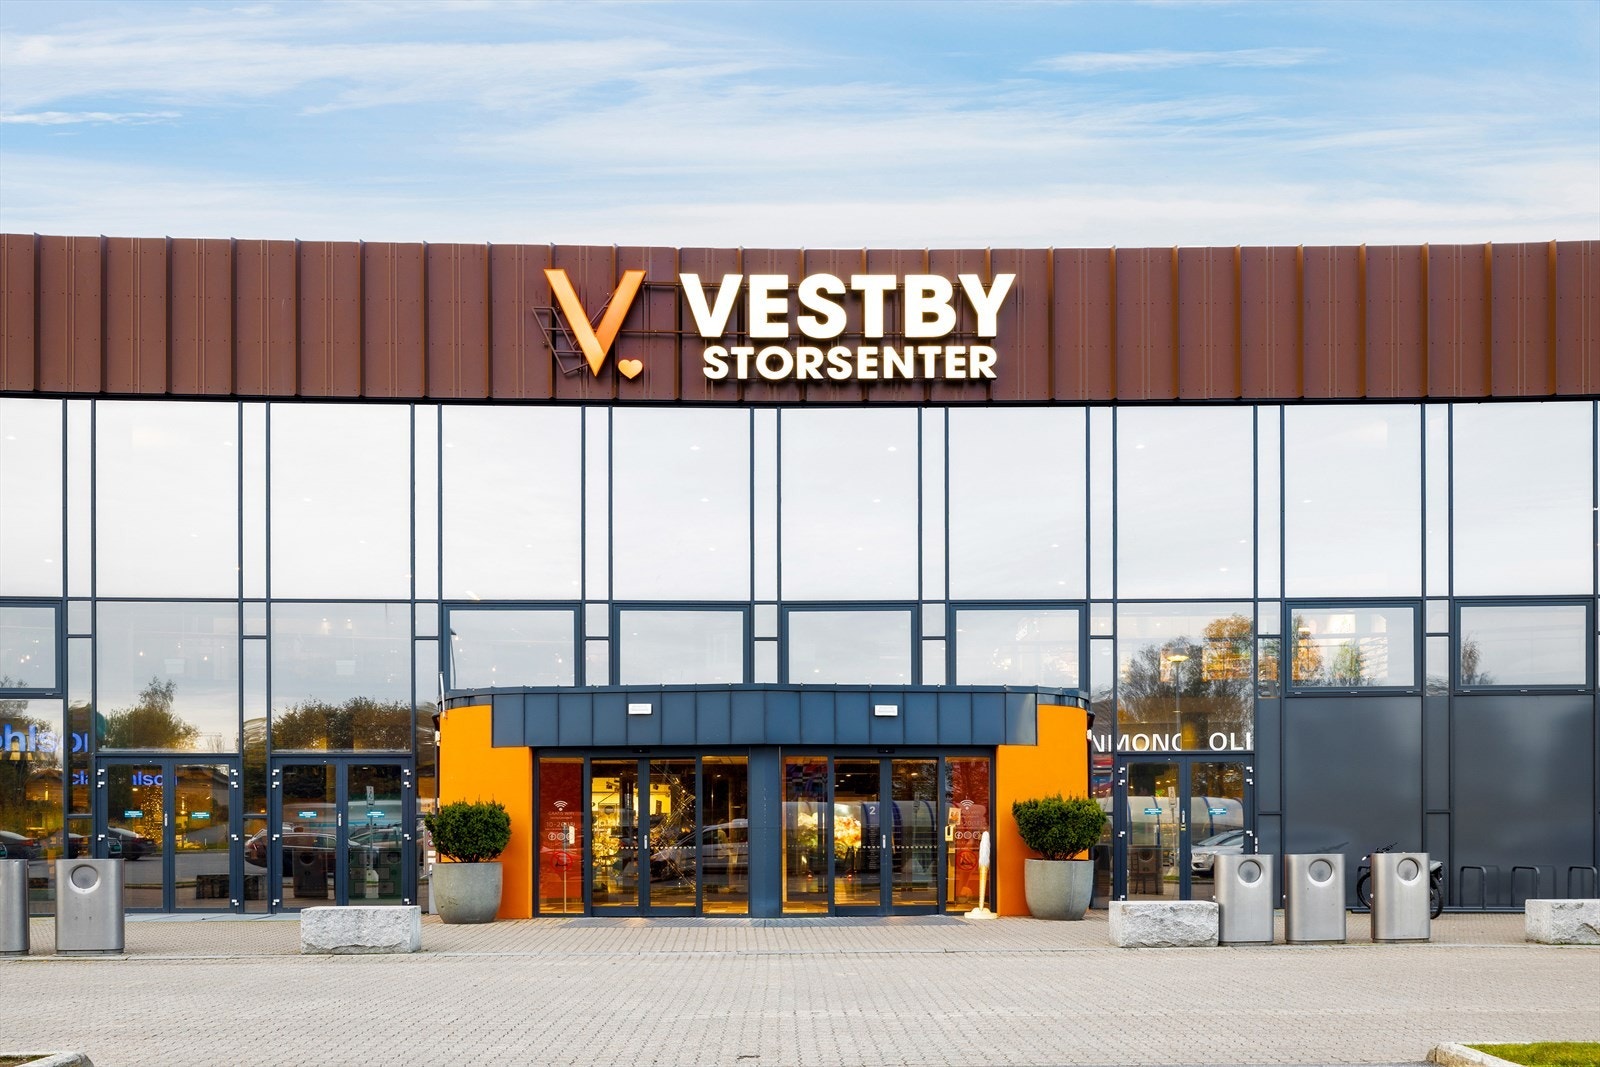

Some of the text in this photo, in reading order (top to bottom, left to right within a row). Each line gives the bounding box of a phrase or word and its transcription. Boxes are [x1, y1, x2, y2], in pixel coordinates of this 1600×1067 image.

[679, 273, 1017, 338] VESTBY
[703, 345, 998, 381] STORSENTER
[869, 806, 876, 815] 2
